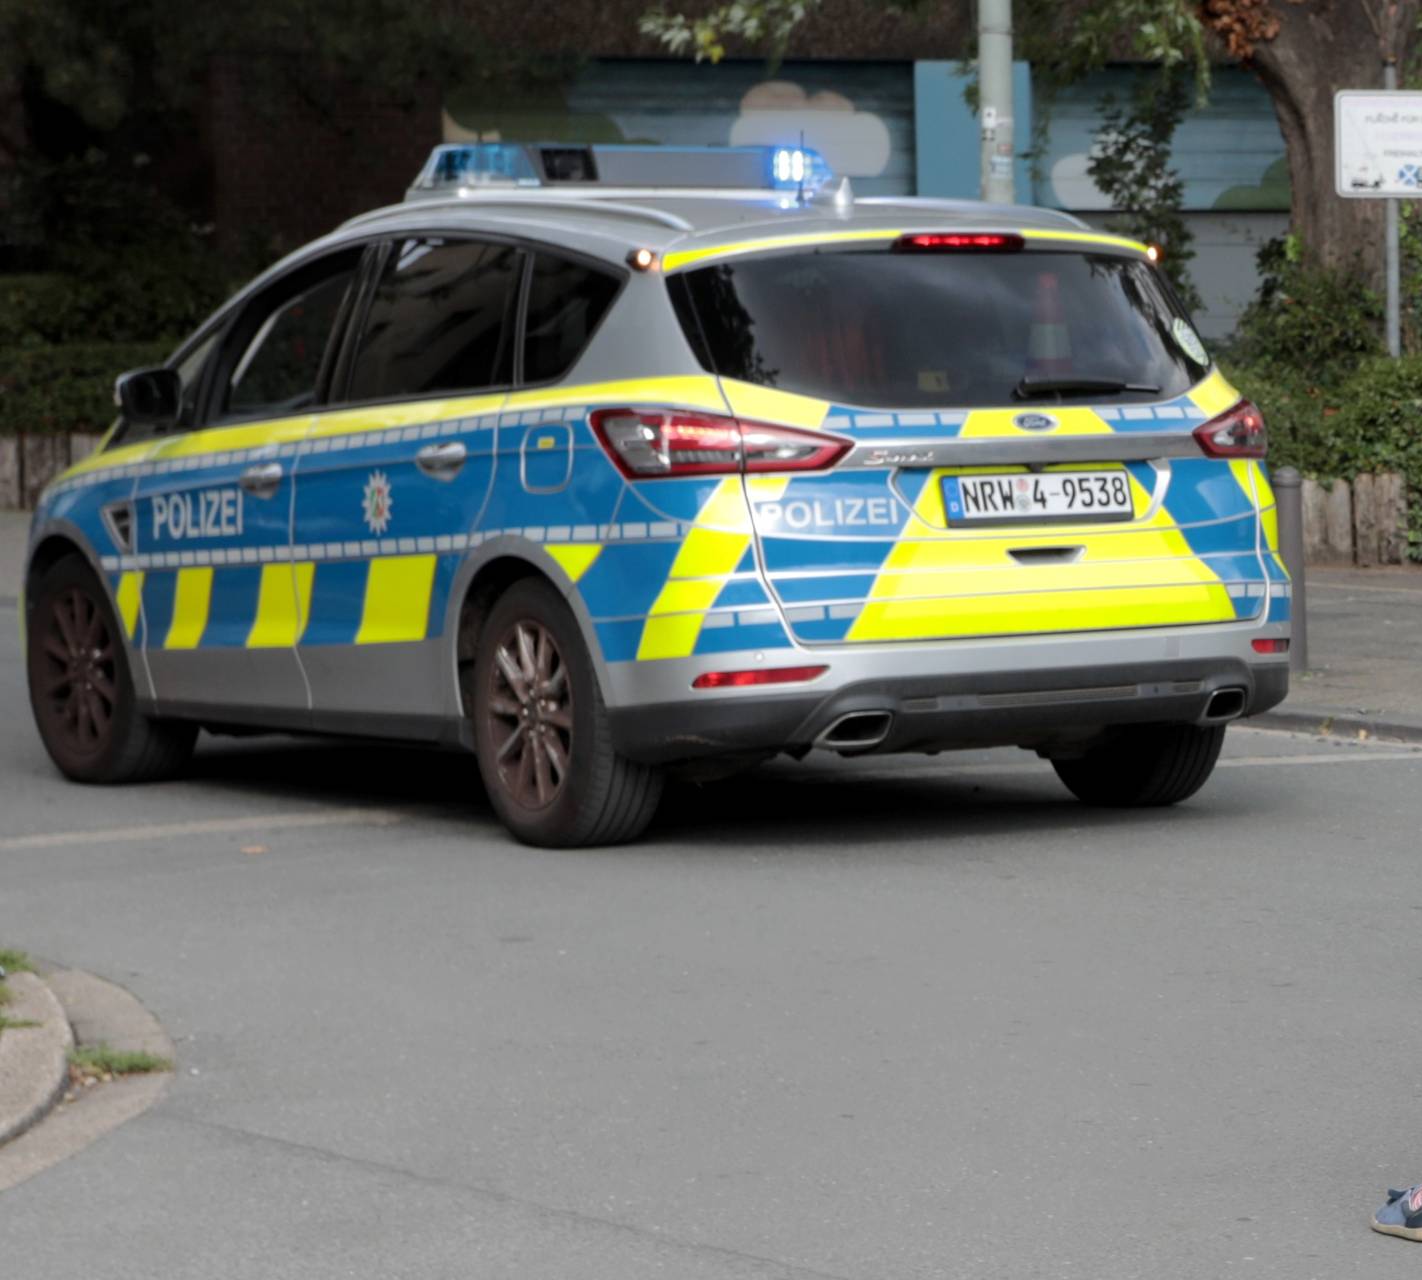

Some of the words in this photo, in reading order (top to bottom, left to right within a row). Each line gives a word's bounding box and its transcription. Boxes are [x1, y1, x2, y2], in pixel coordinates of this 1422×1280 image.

[962, 479, 1015, 513] NRW
[1033, 477, 1127, 510] 4-9538
[152, 489, 243, 539] POLIZEI
[759, 498, 898, 529] POLIZEI
